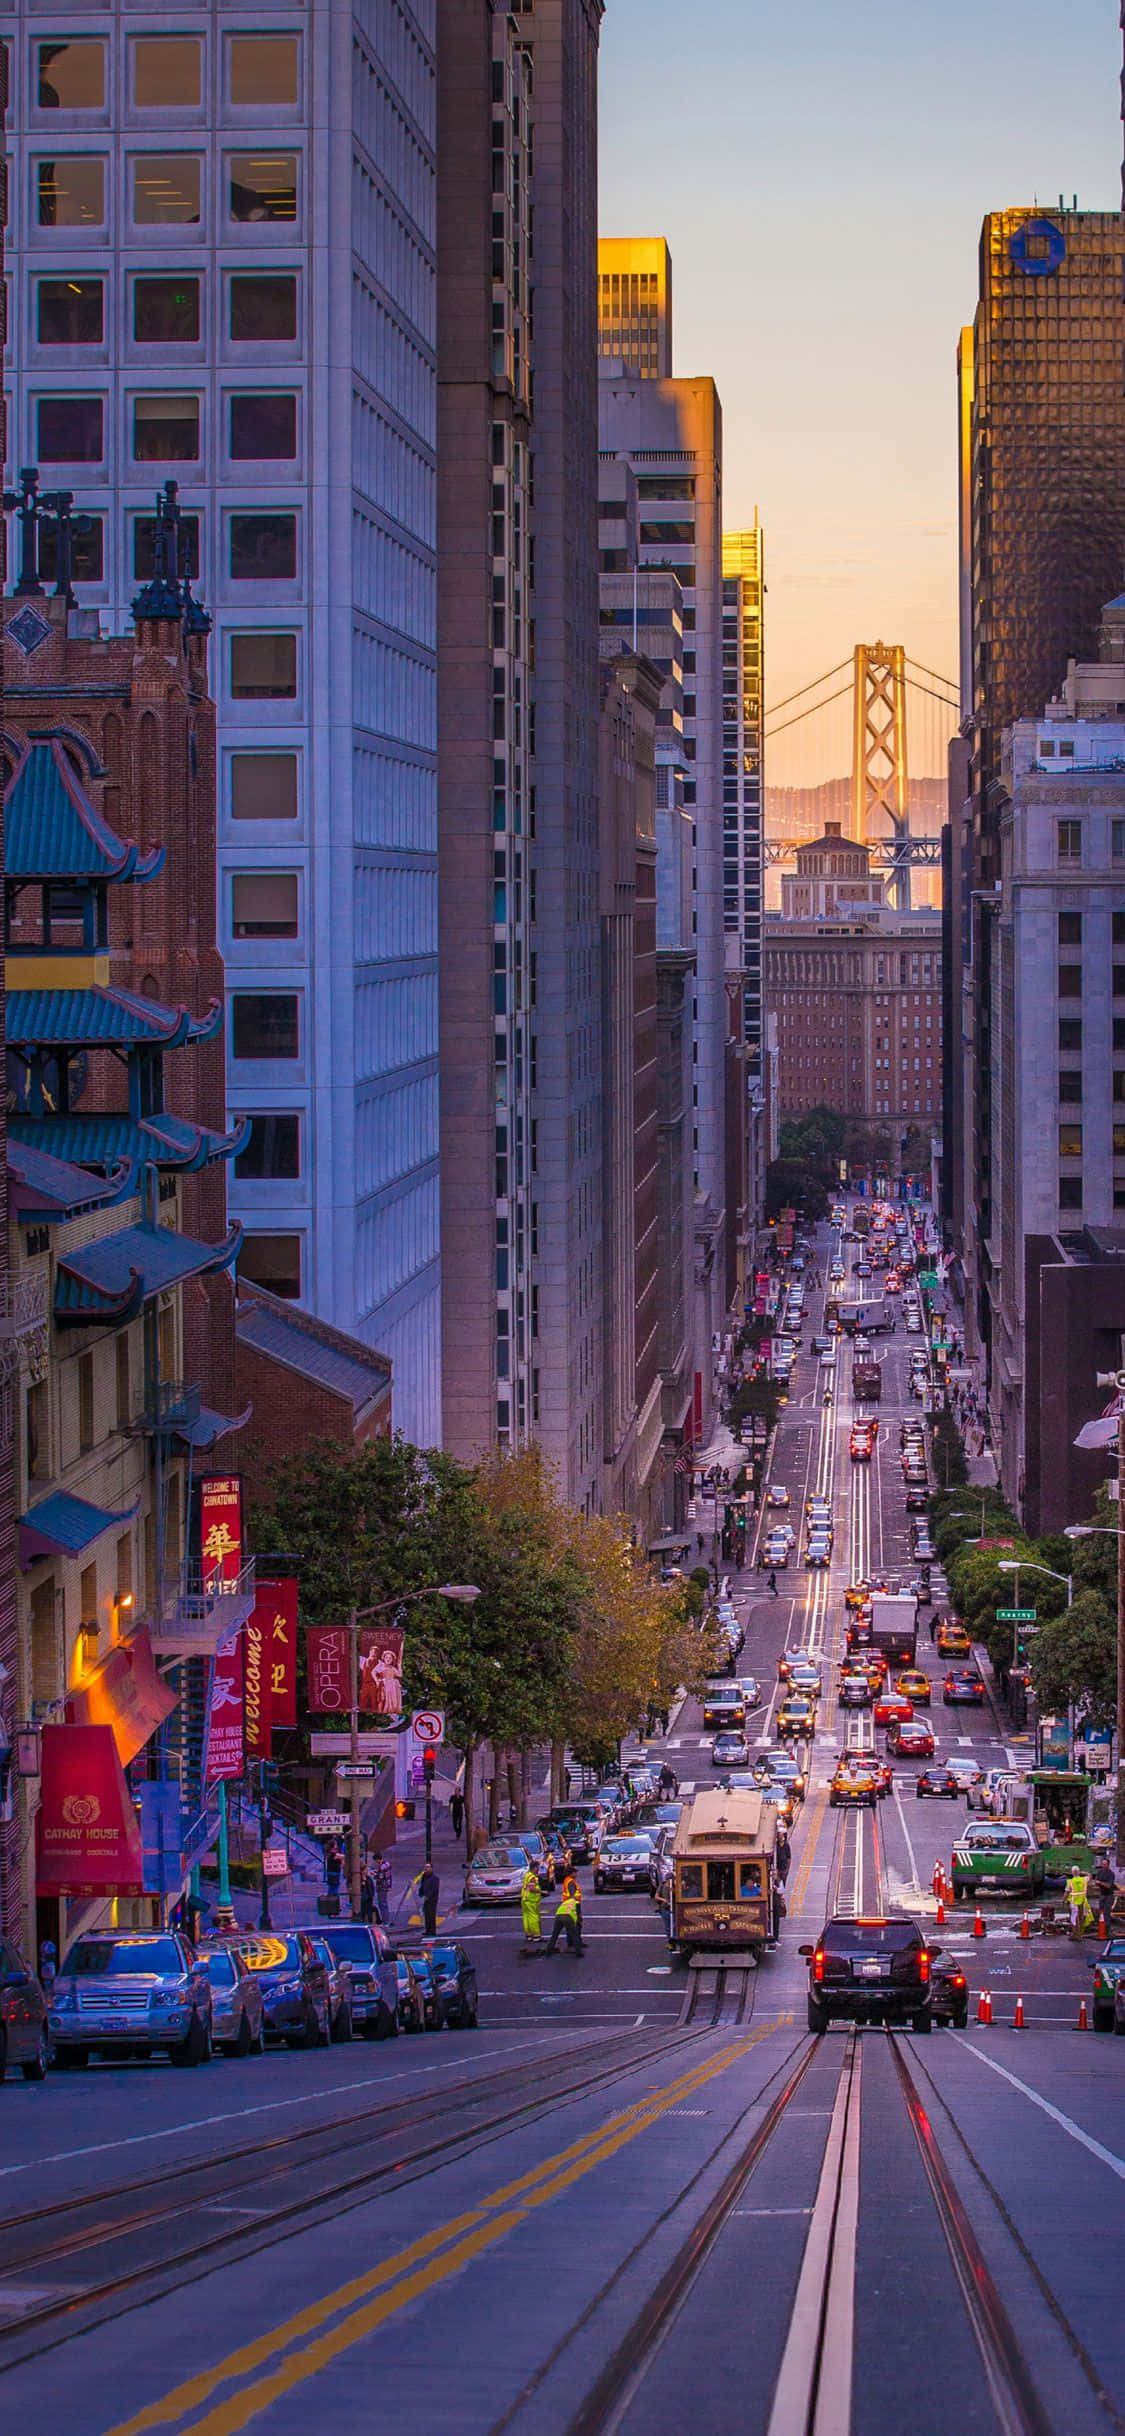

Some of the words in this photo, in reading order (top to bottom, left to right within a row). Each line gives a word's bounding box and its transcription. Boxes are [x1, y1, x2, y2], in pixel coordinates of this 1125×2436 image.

[202, 1481, 230, 1493] WELCOME
[231, 1480, 239, 1492] TO
[203, 1494, 238, 1507] CHINATOWN
[319, 1631, 341, 1708] OPERA
[208, 1738, 242, 1751] ESTAURANT
[207, 1752, 236, 1763] OCKTAILS
[310, 1815, 348, 1824] GRANT
[44, 1828, 82, 1839] CATHAY
[86, 1828, 119, 1839] HOUSE
[713, 1913, 730, 1921] 58
